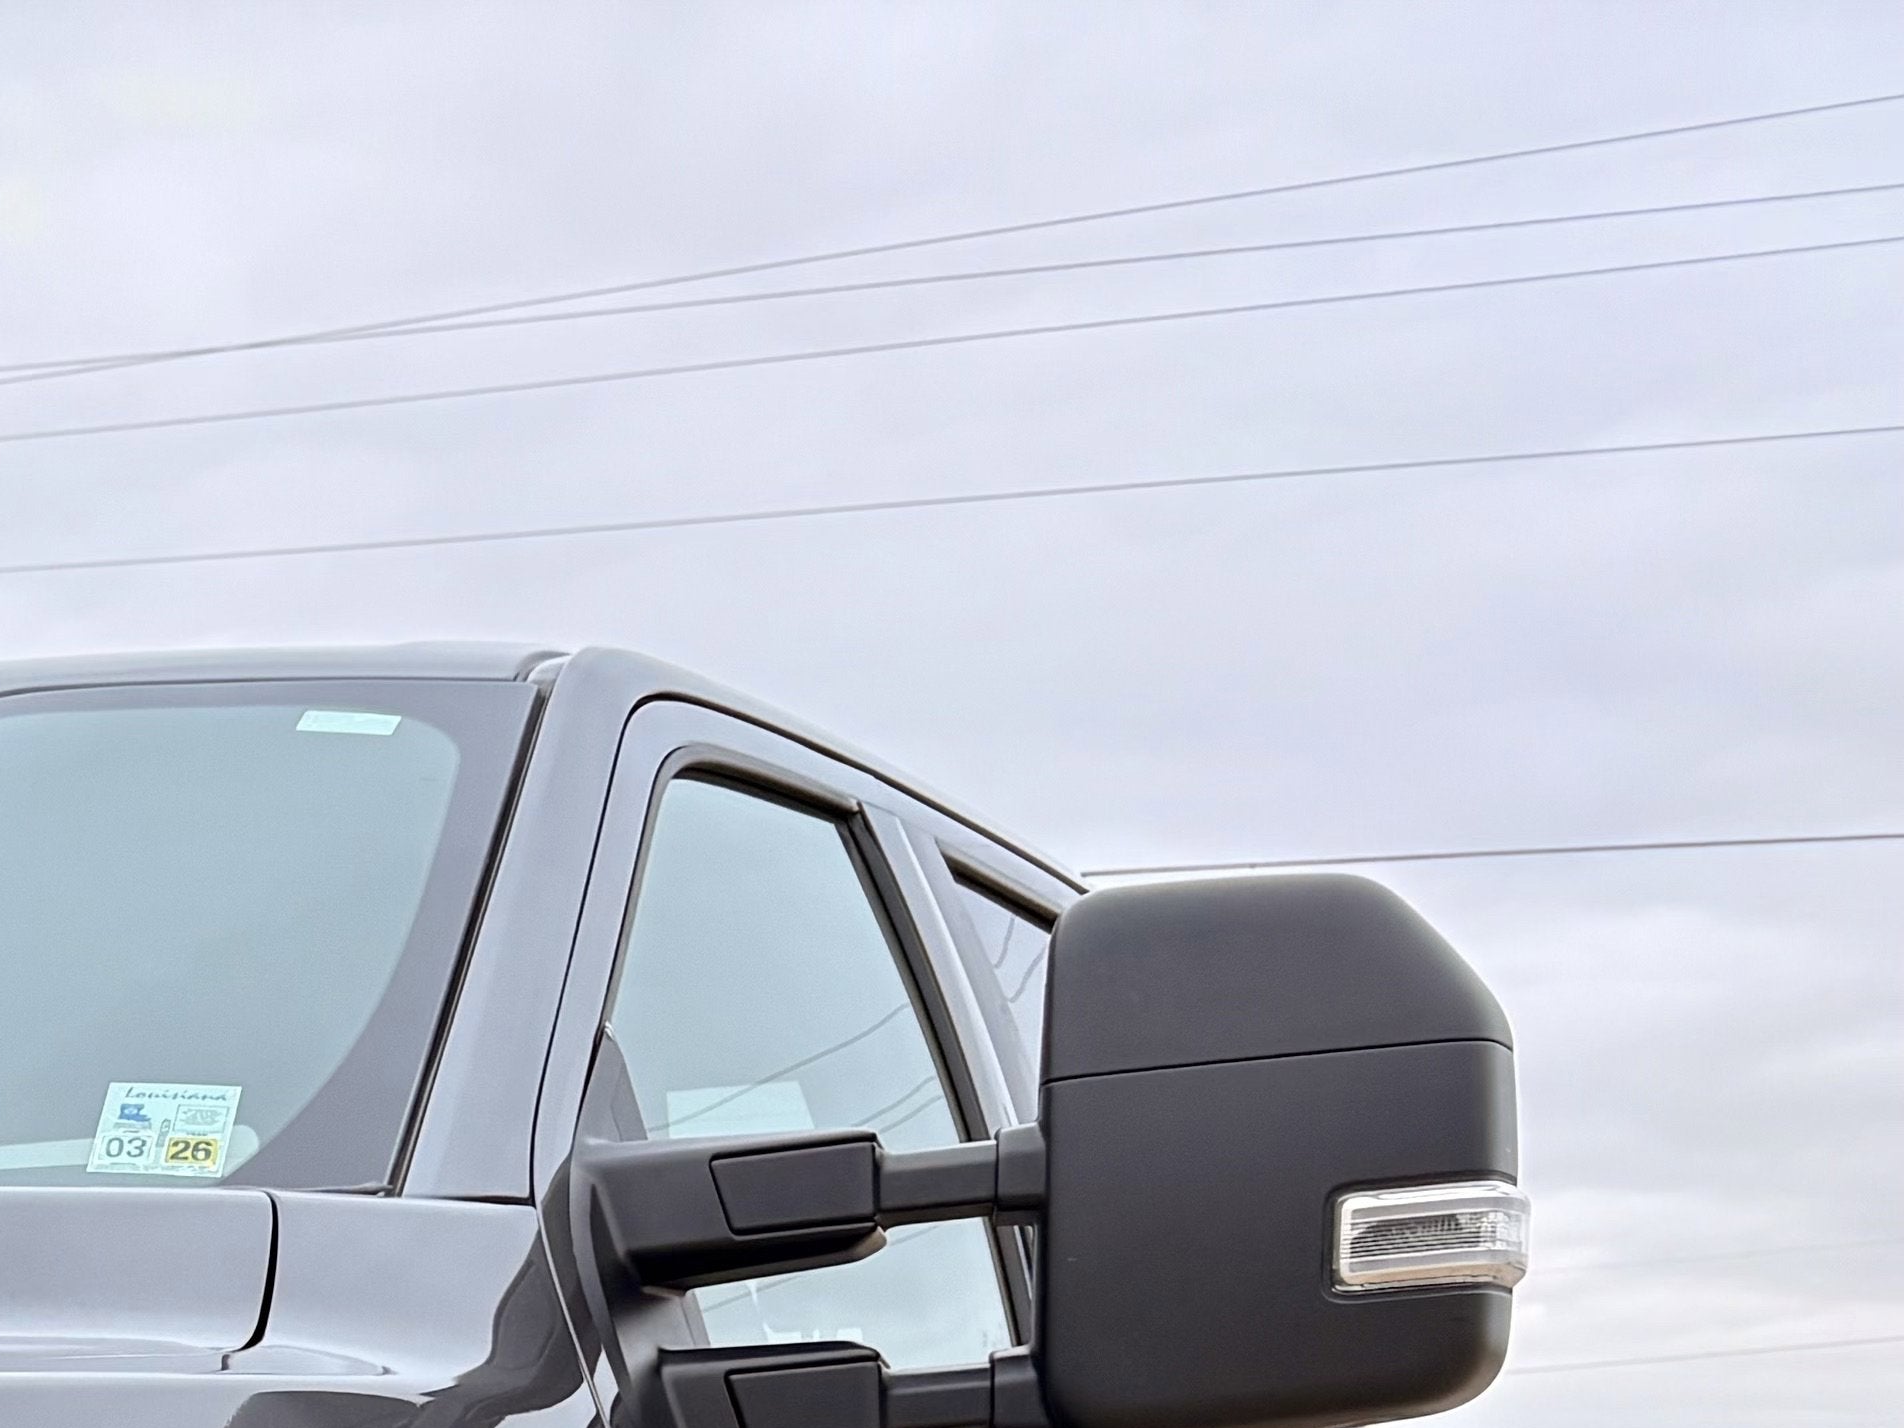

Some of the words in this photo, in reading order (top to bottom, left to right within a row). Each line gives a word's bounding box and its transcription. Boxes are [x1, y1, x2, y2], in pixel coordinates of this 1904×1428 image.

[124, 1086, 228, 1103] Louisiana
[104, 1136, 147, 1159] 03
[168, 1139, 213, 1162] 26
